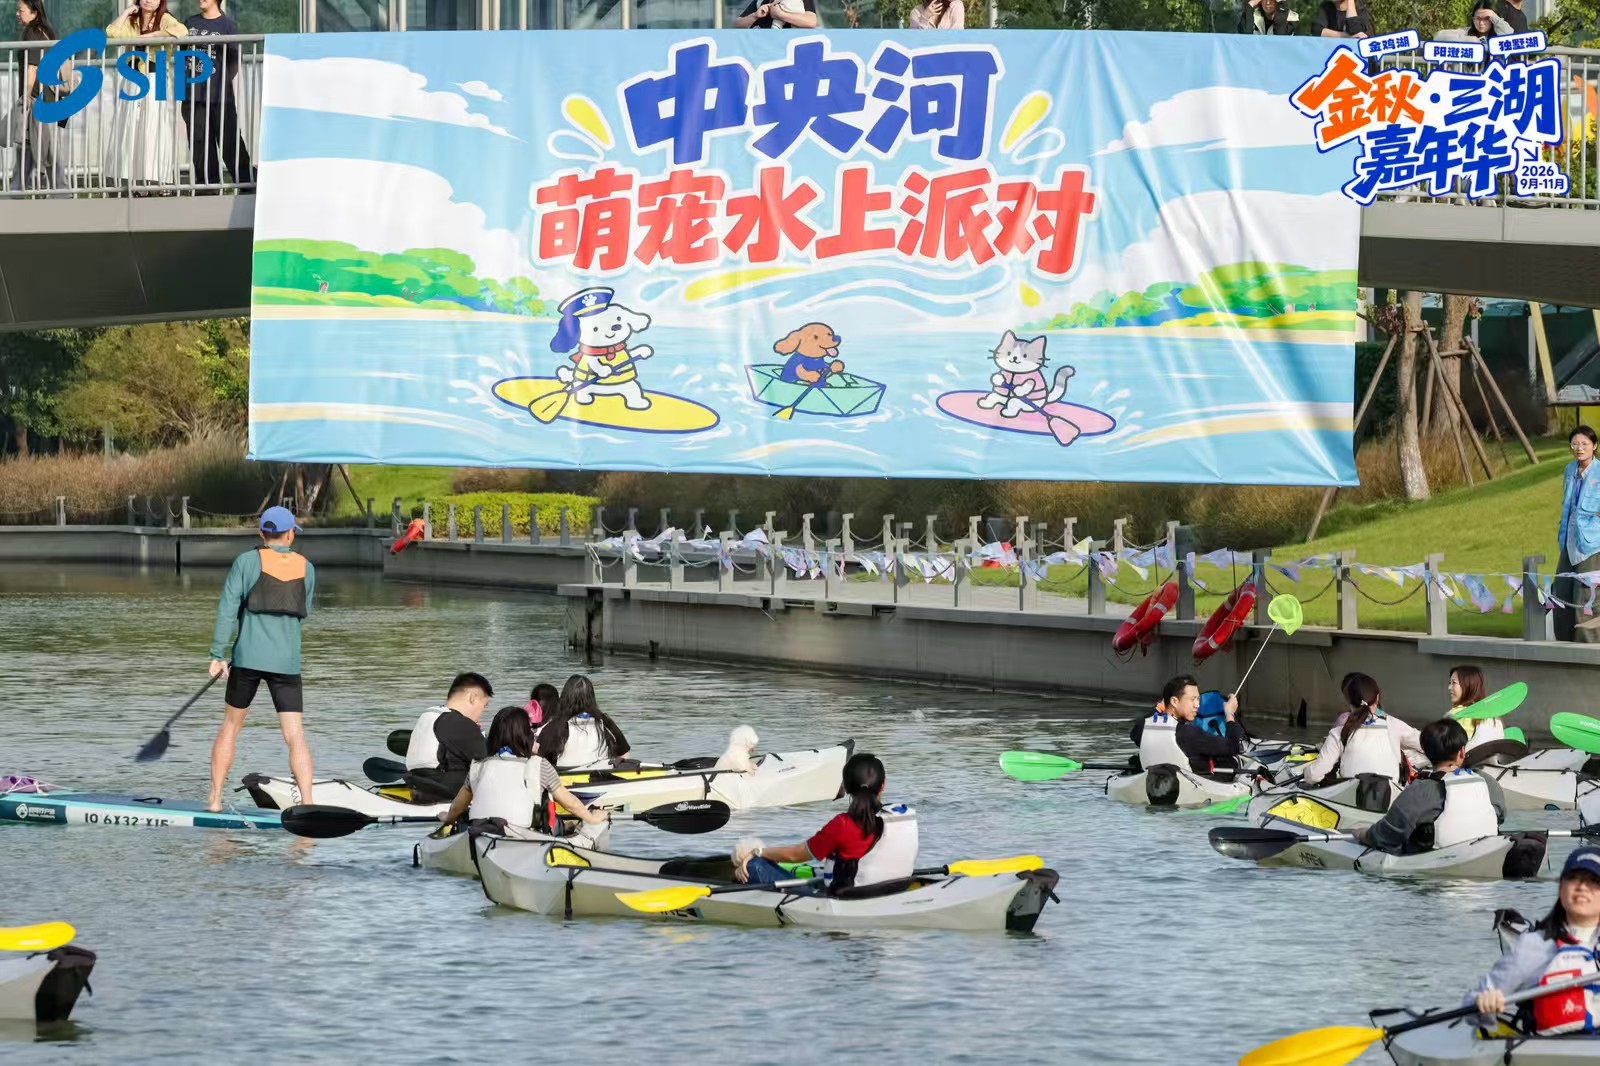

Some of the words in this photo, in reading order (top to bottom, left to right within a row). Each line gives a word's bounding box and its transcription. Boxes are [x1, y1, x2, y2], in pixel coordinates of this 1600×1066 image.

[623, 41, 998, 164] 中央河
[536, 166, 1095, 274] 萌宠水上派对
